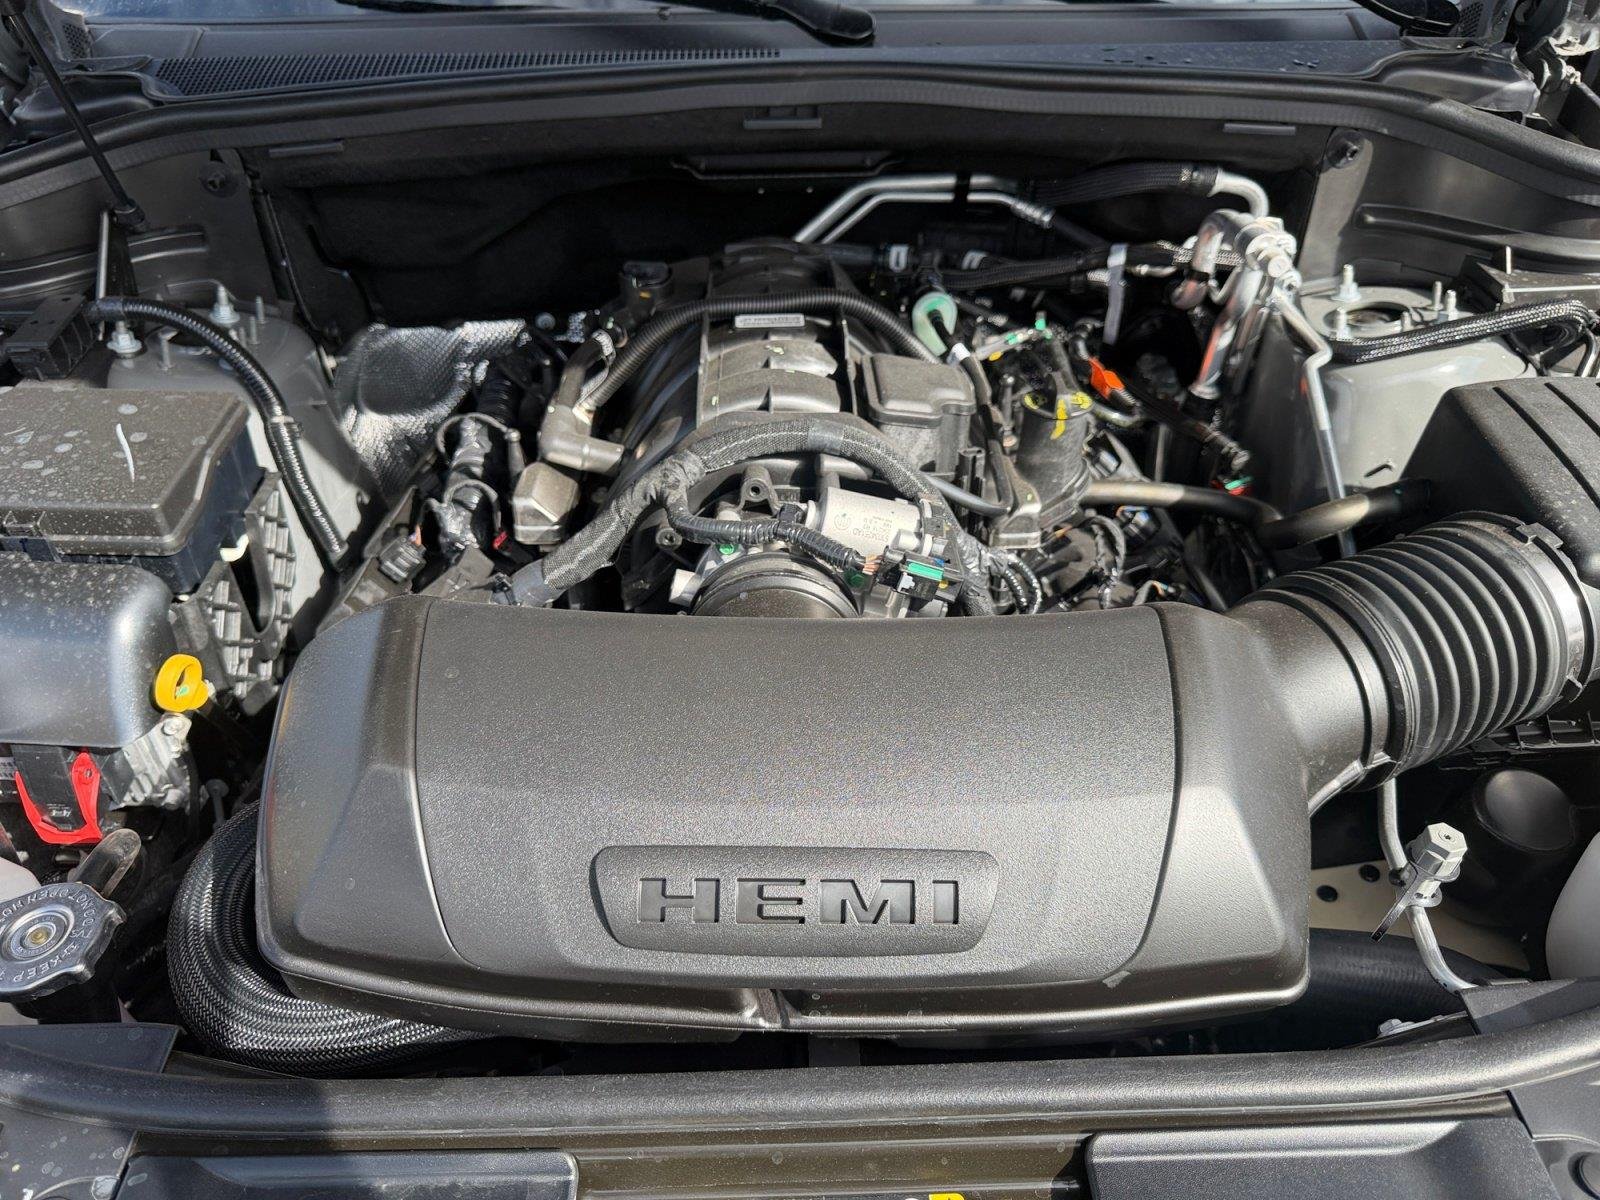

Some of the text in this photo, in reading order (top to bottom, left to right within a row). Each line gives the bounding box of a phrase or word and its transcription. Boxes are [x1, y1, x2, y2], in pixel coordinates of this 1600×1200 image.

[27, 889, 69, 904] OPEN
[68, 889, 94, 910] NOT
[638, 878, 959, 924] HEMI
[13, 954, 62, 982] KEEP
